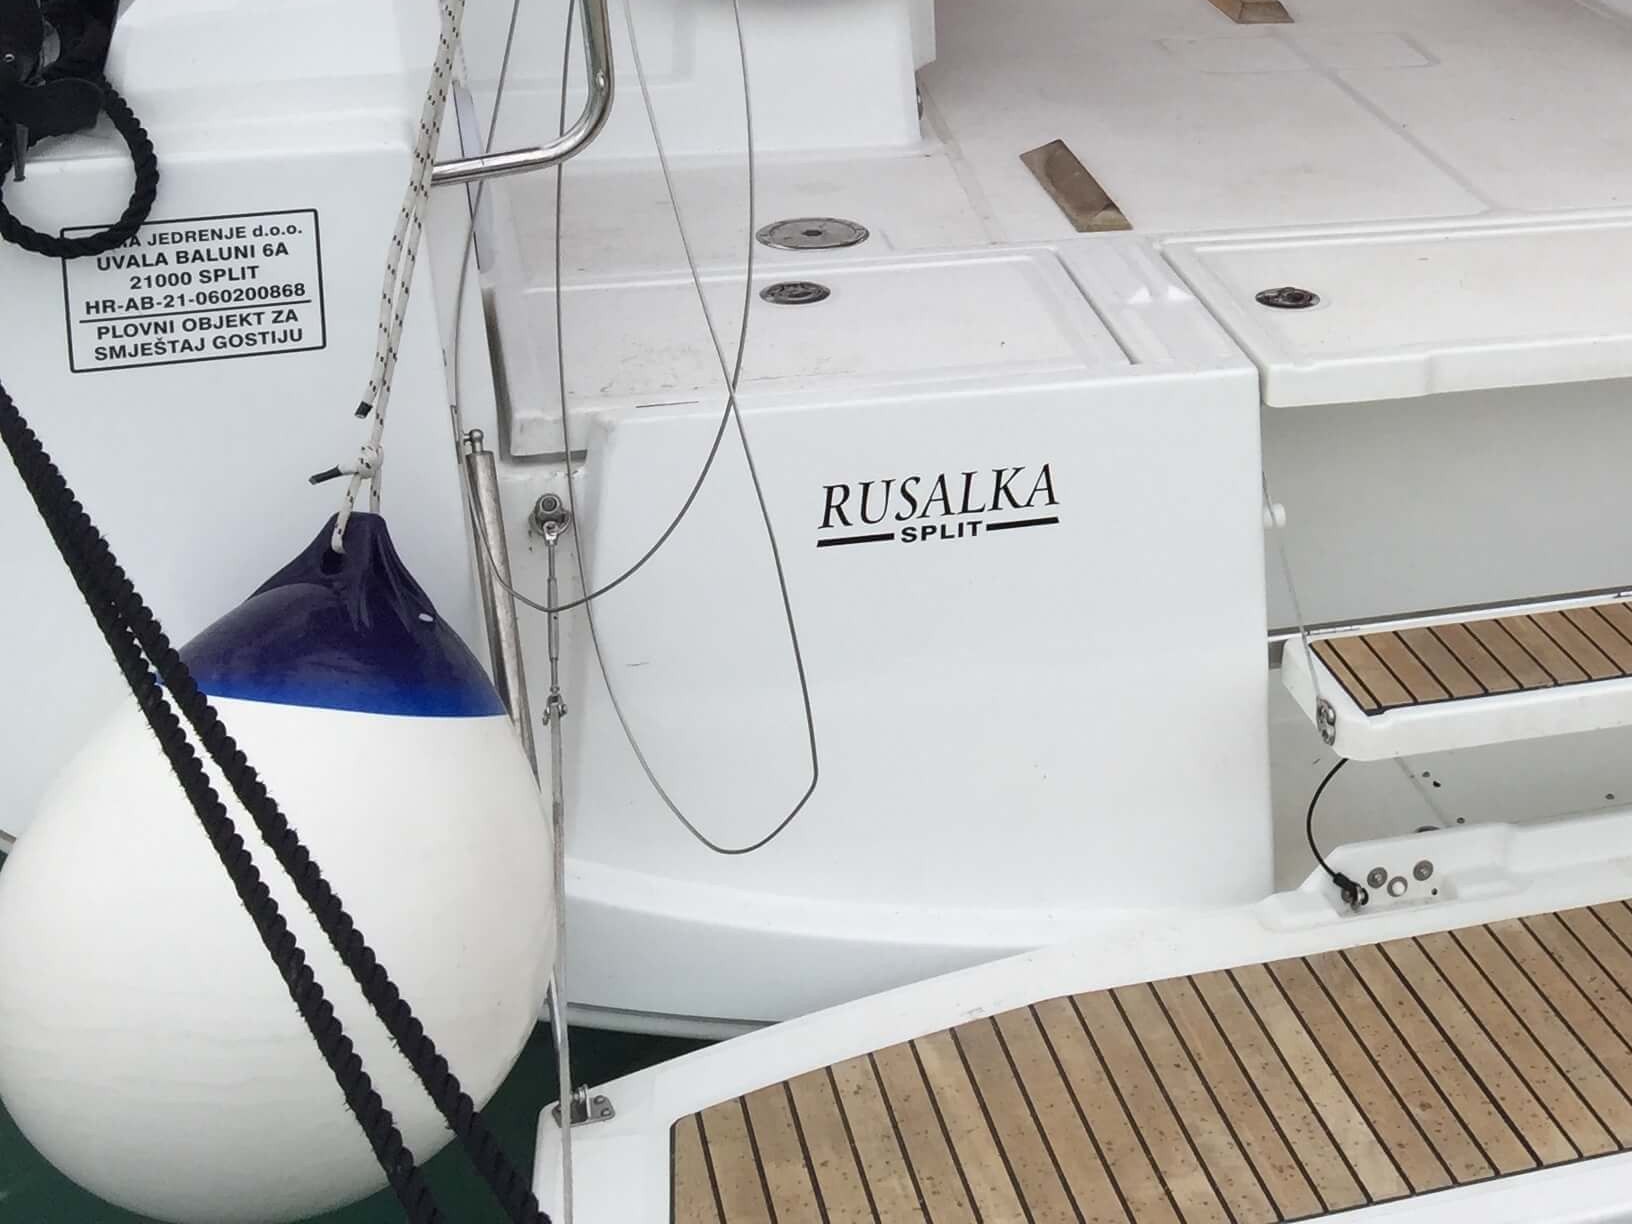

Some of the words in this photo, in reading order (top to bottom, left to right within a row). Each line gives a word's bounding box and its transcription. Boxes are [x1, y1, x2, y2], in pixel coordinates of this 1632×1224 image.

[147, 225, 247, 247] JEDRENJE
[252, 224, 303, 237] d.o.o.
[96, 251, 169, 271] UVALA
[175, 244, 256, 265] BALUNI
[262, 241, 289, 258] 6A
[129, 271, 192, 290] 21000
[199, 265, 260, 284] SPLIT
[85, 282, 306, 315] HR-AB-21-060200868
[96, 319, 175, 340] PLOVNI
[182, 311, 266, 333] OBJEKT
[271, 308, 299, 323] ZA
[94, 337, 206, 361] SMJEŠTAJ
[212, 327, 303, 350] GOSTIJU
[817, 463, 1060, 529] RUSALKA
[901, 520, 983, 543] SPLIT
